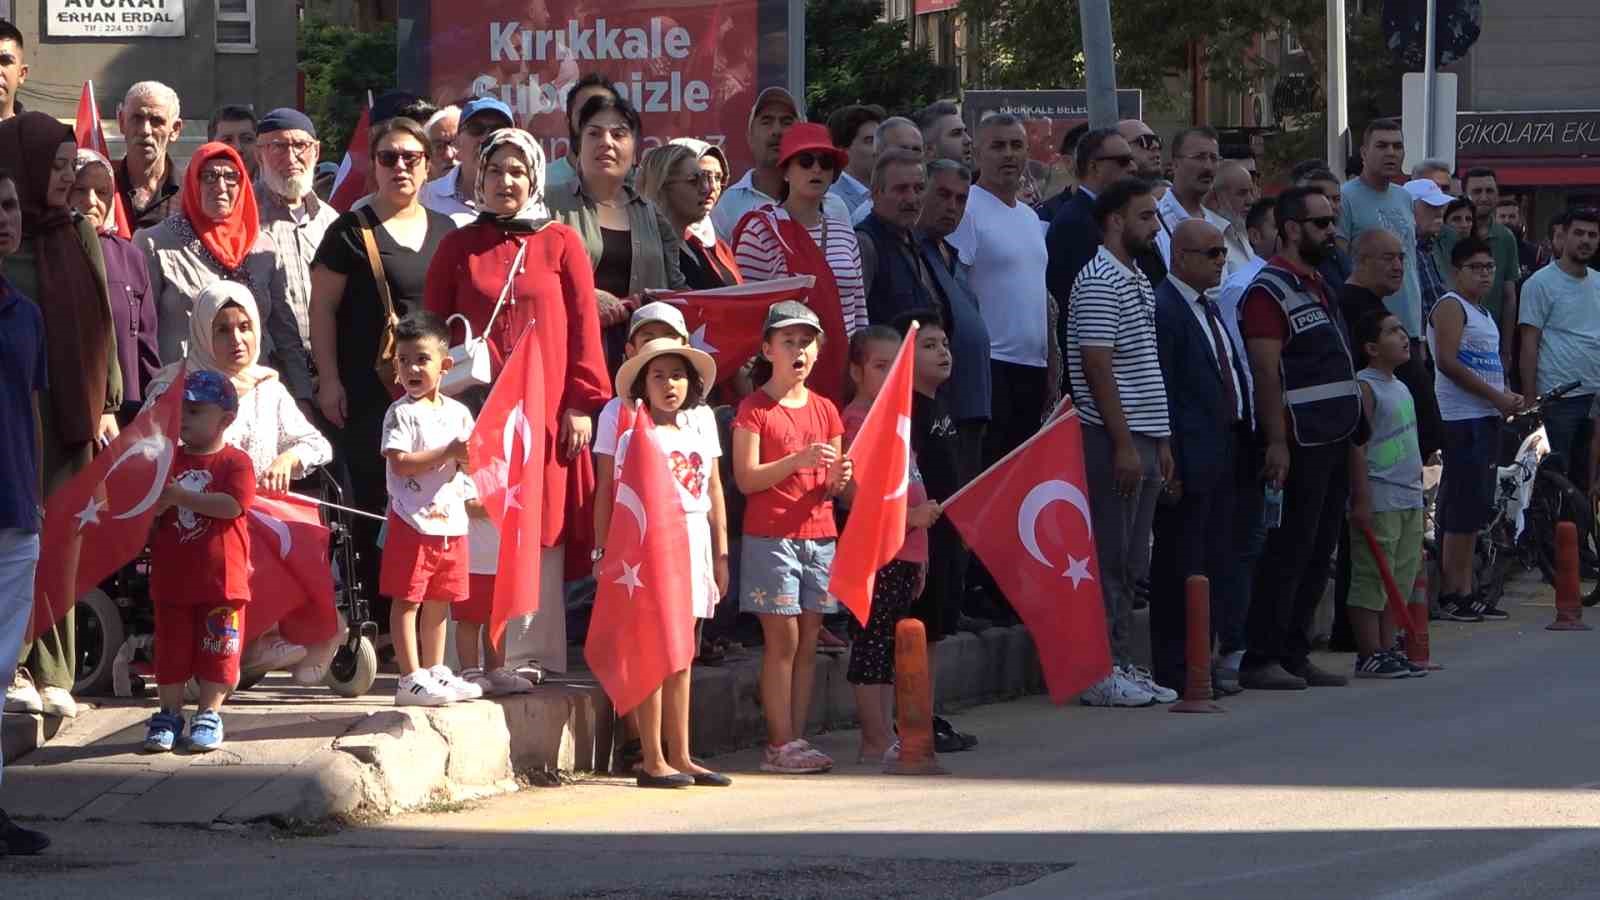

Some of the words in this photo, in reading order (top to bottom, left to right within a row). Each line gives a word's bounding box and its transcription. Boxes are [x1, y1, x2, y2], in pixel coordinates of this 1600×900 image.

[57, 12, 115, 23] ERHAN
[122, 12, 174, 23] ERDAL
[489, 16, 692, 61] Kırıkkale
